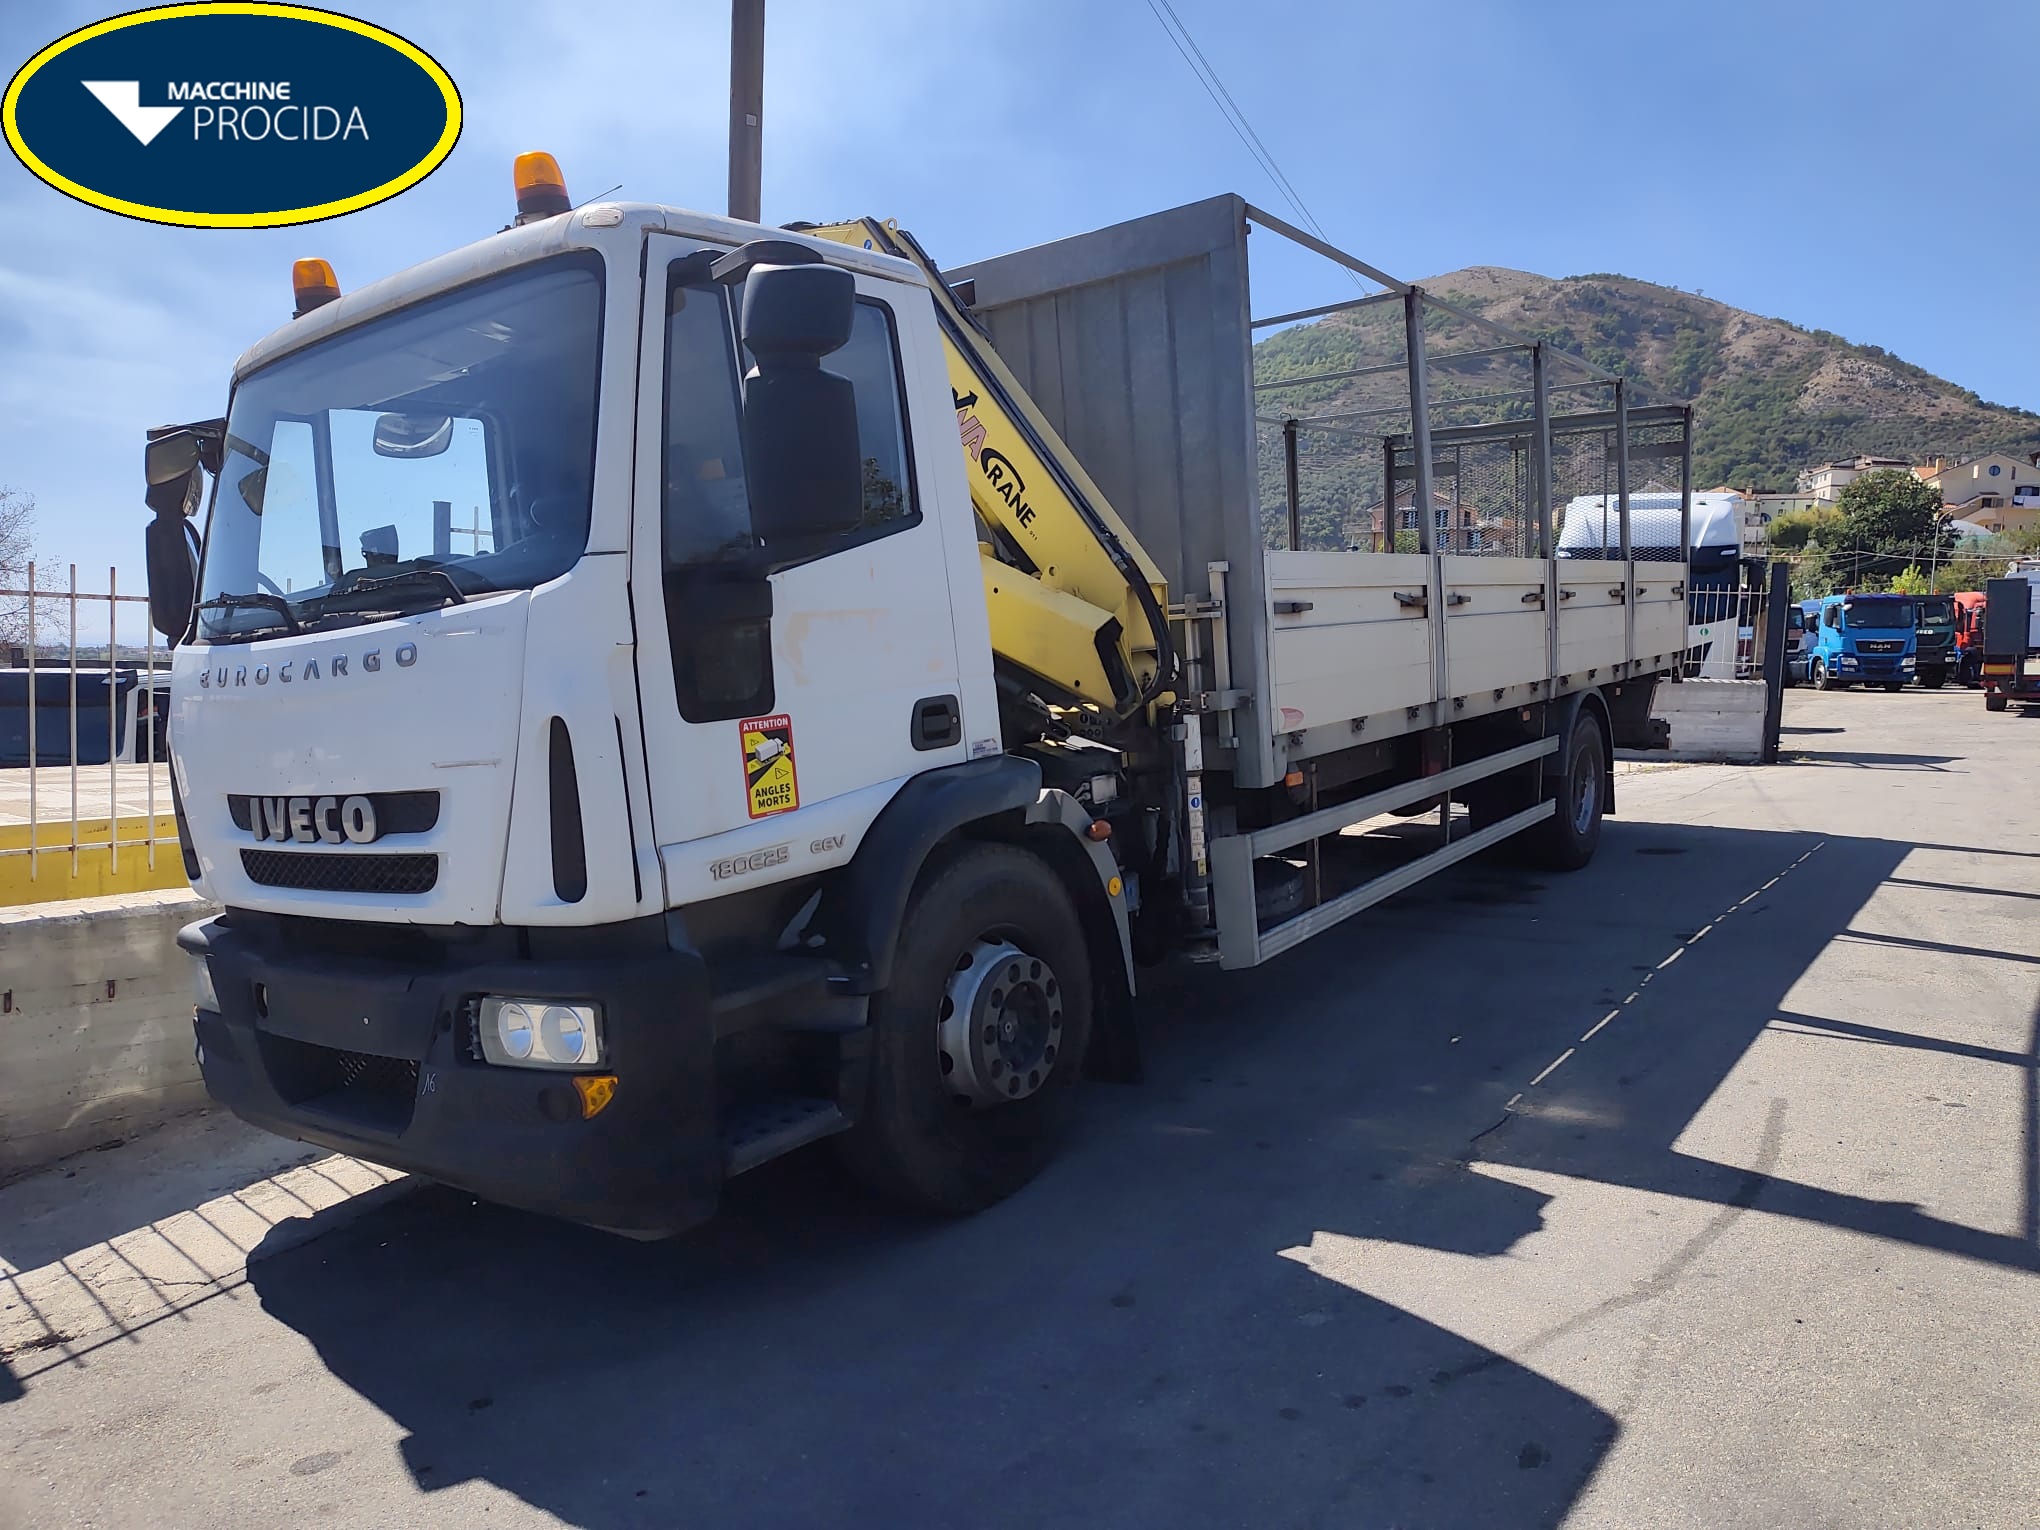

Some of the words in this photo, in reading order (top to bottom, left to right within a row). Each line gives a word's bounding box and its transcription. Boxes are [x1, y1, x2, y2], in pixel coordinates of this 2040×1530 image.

[200, 641, 418, 688] EUROCARGO
[743, 717, 789, 732] ATTENTION
[755, 782, 791, 799] ANGLES
[757, 794, 791, 809] MORTS
[250, 796, 377, 844] IVECO
[709, 846, 790, 881] 180E25
[809, 834, 845, 854] EEV
